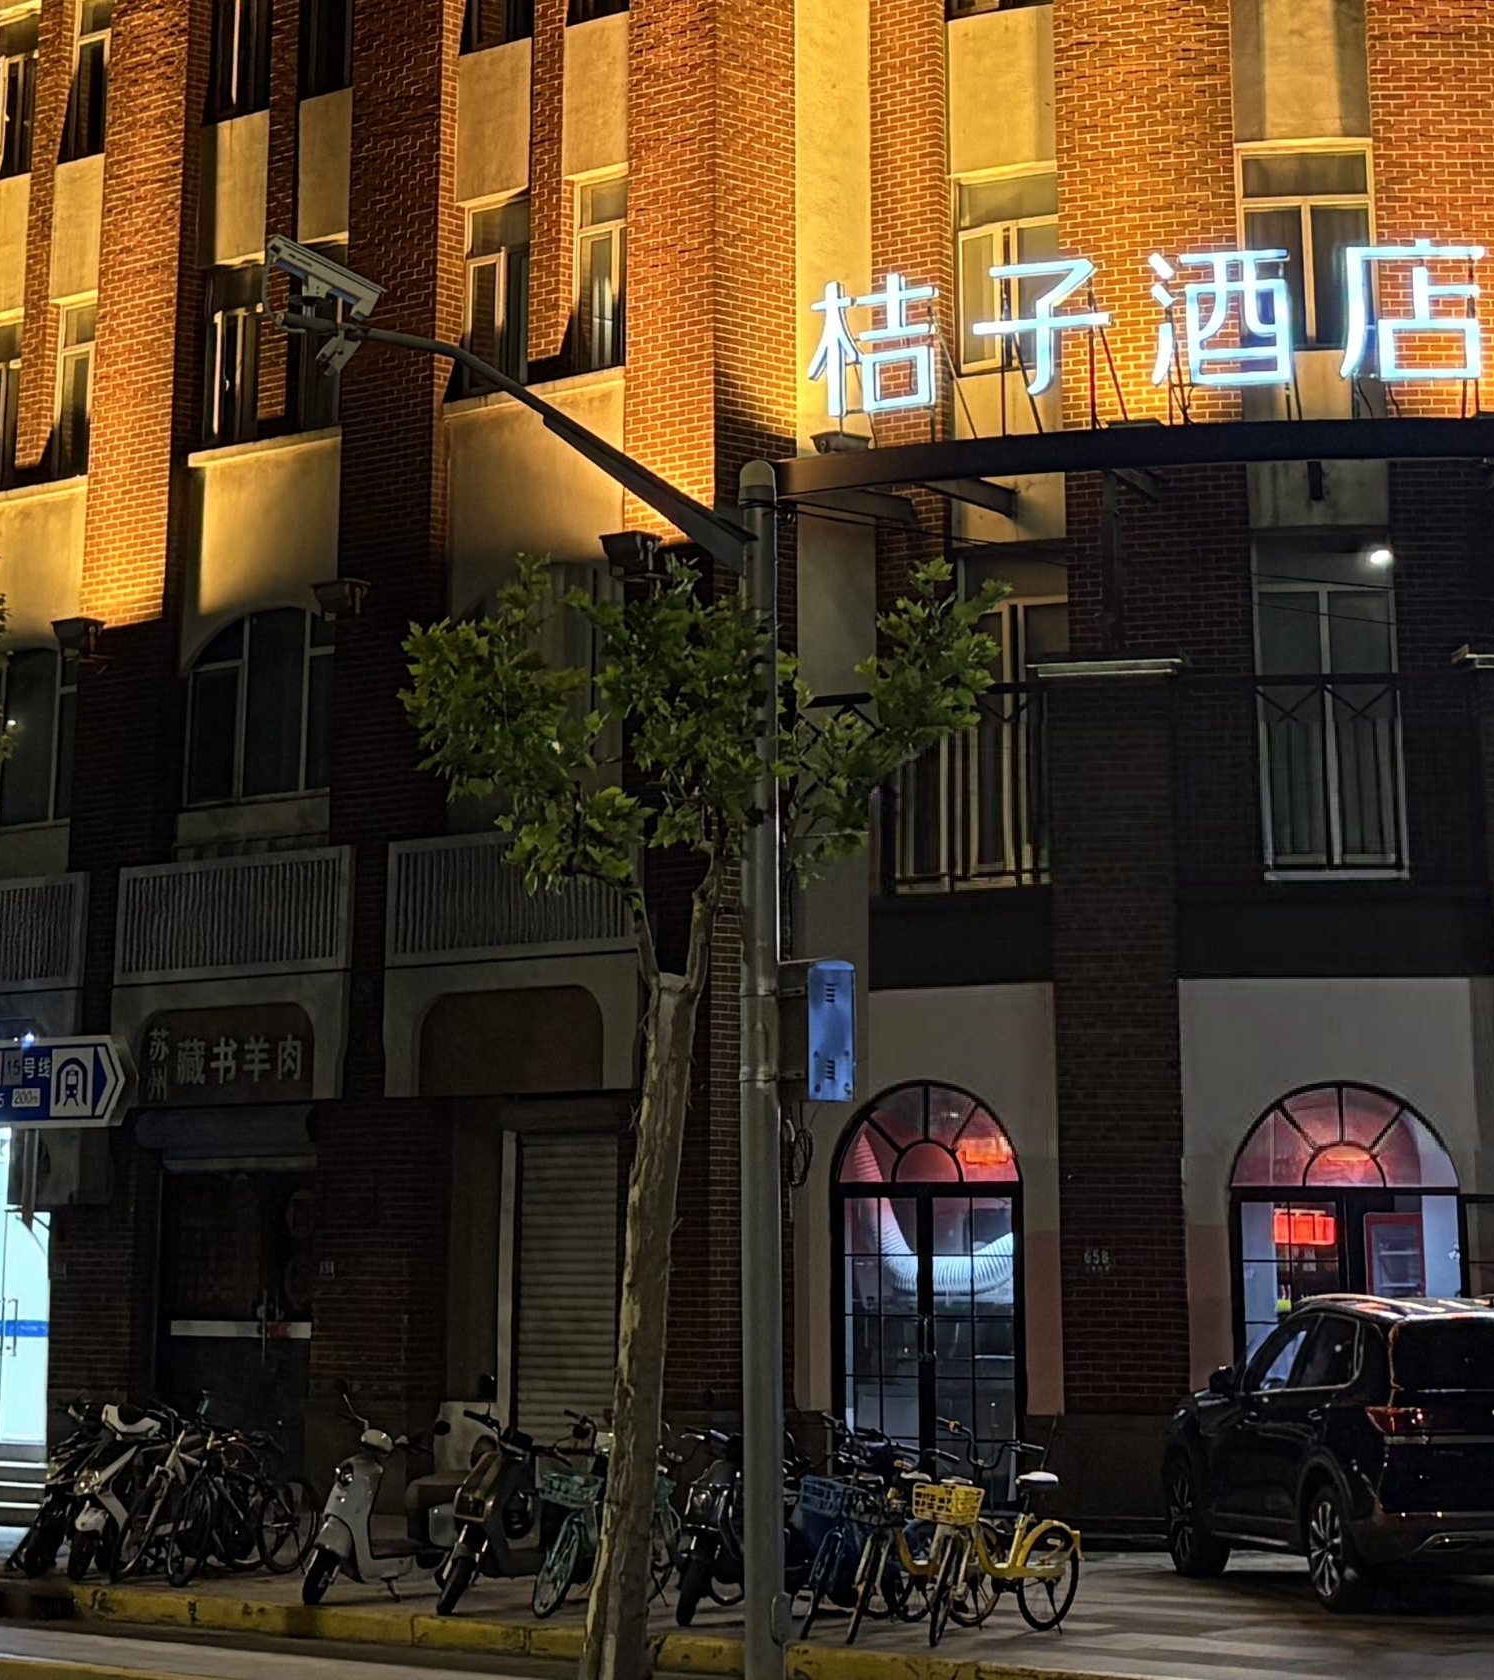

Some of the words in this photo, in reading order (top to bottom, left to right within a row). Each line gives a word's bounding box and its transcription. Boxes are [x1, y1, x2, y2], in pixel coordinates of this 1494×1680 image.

[808, 239, 1487, 419] 桔子酒店
[23, 1056, 52, 1080] 号线
[148, 1027, 170, 1101] 苏州
[176, 1034, 302, 1085] 藏书羊肉
